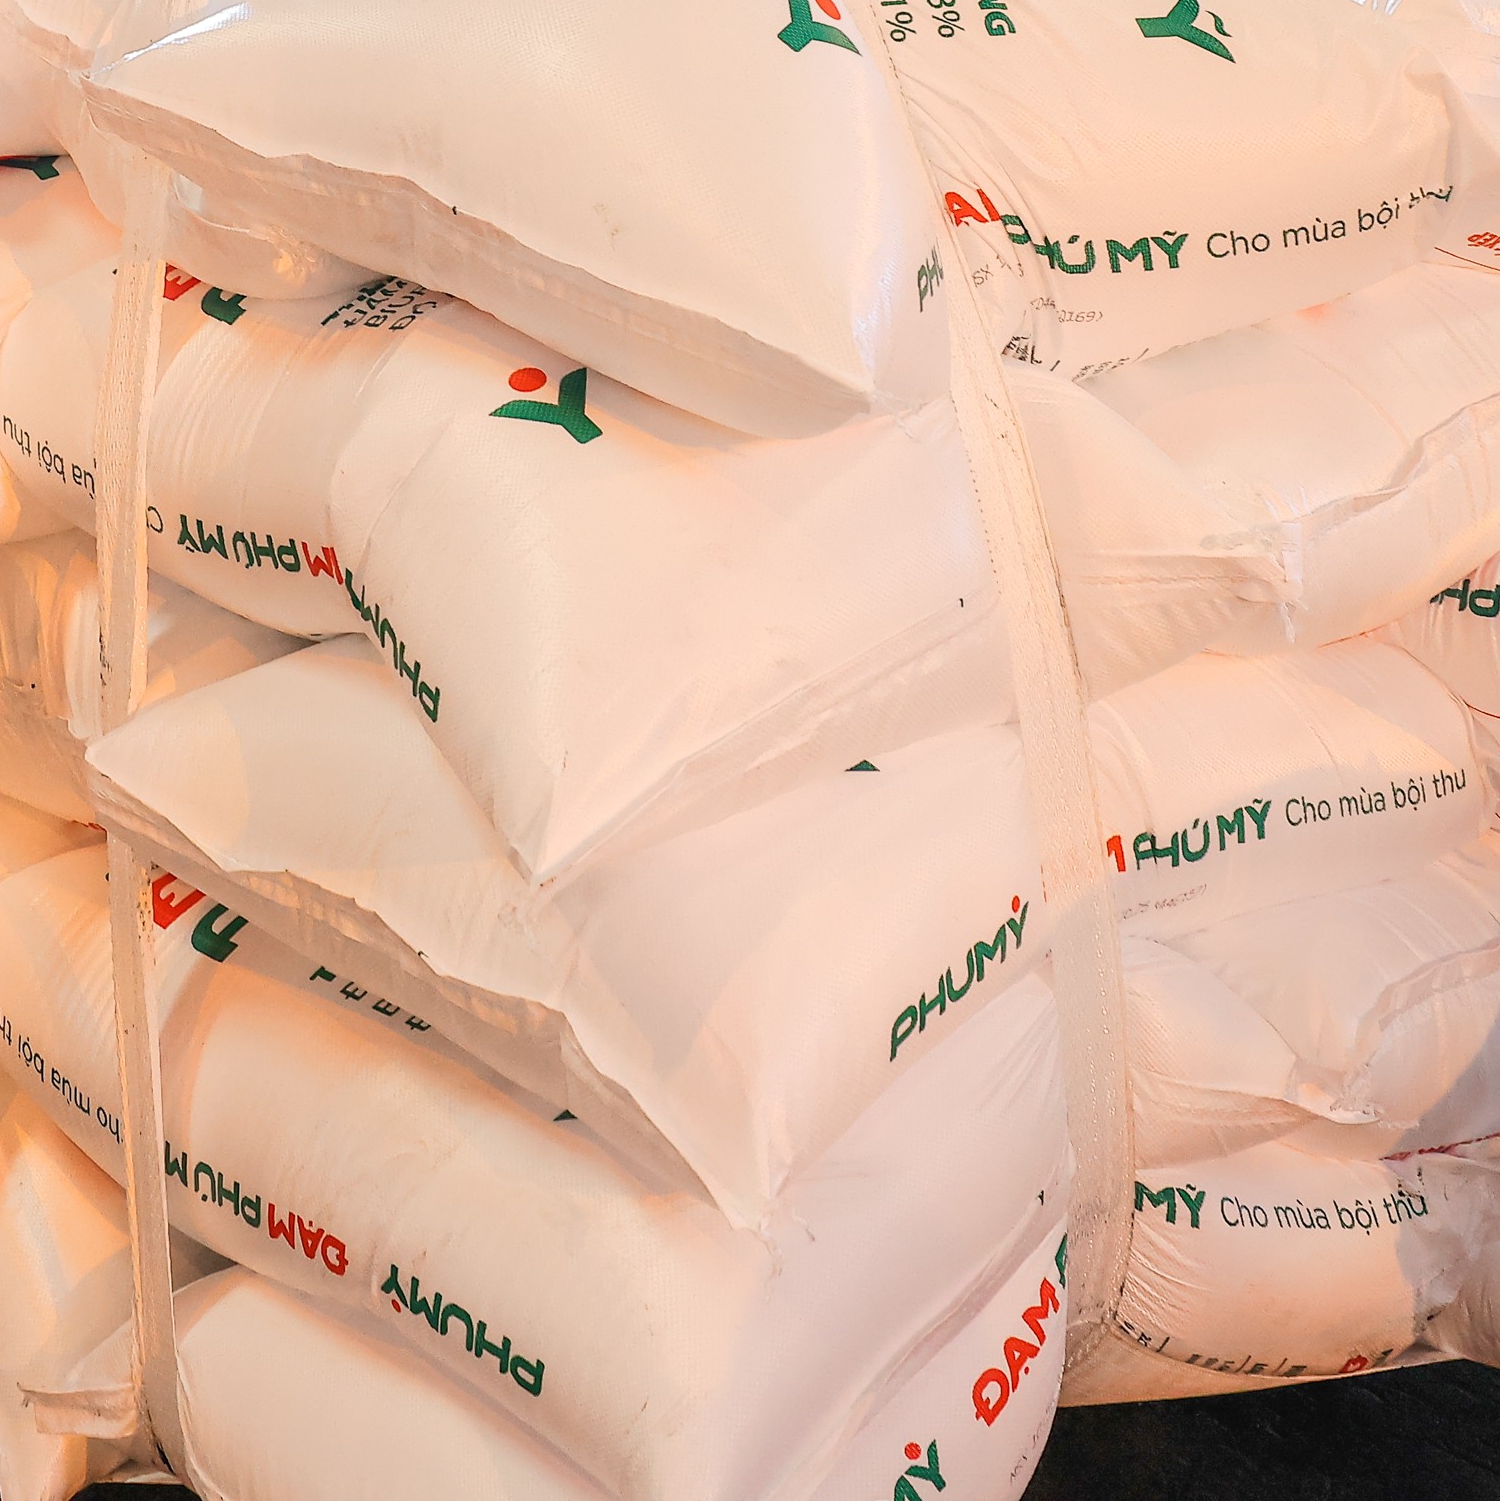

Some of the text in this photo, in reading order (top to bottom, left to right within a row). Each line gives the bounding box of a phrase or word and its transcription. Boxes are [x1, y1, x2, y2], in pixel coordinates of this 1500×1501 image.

[1105, 230, 1189, 274] MỸ
[1206, 231, 1270, 258] Cho
[1282, 217, 1347, 249] mùa
[1357, 196, 1400, 232] bội
[2, 413, 31, 445] thu
[37, 440, 66, 483] bội
[71, 461, 97, 499] ùa
[177, 514, 228, 560] MỸ
[232, 529, 301, 573] PHÚ
[1215, 798, 1272, 852] MỸ
[1285, 798, 1332, 828] Cho
[1338, 787, 1387, 818] mùa
[1390, 778, 1427, 812] bội
[1432, 768, 1467, 799] thu
[889, 894, 1030, 1062] PHUMY
[17, 1035, 46, 1083] bội
[51, 1066, 92, 1117] mùa
[95, 1106, 125, 1145] ho
[164, 1140, 188, 1188] M
[193, 1161, 262, 1228] PHÚ
[1134, 1180, 1430, 1236] MỸ Cho mùa bội thu
[267, 1202, 350, 1277] ĐẠM
[380, 1263, 546, 1398] PHUMY
[972, 1277, 1061, 1427] ĐẠM
